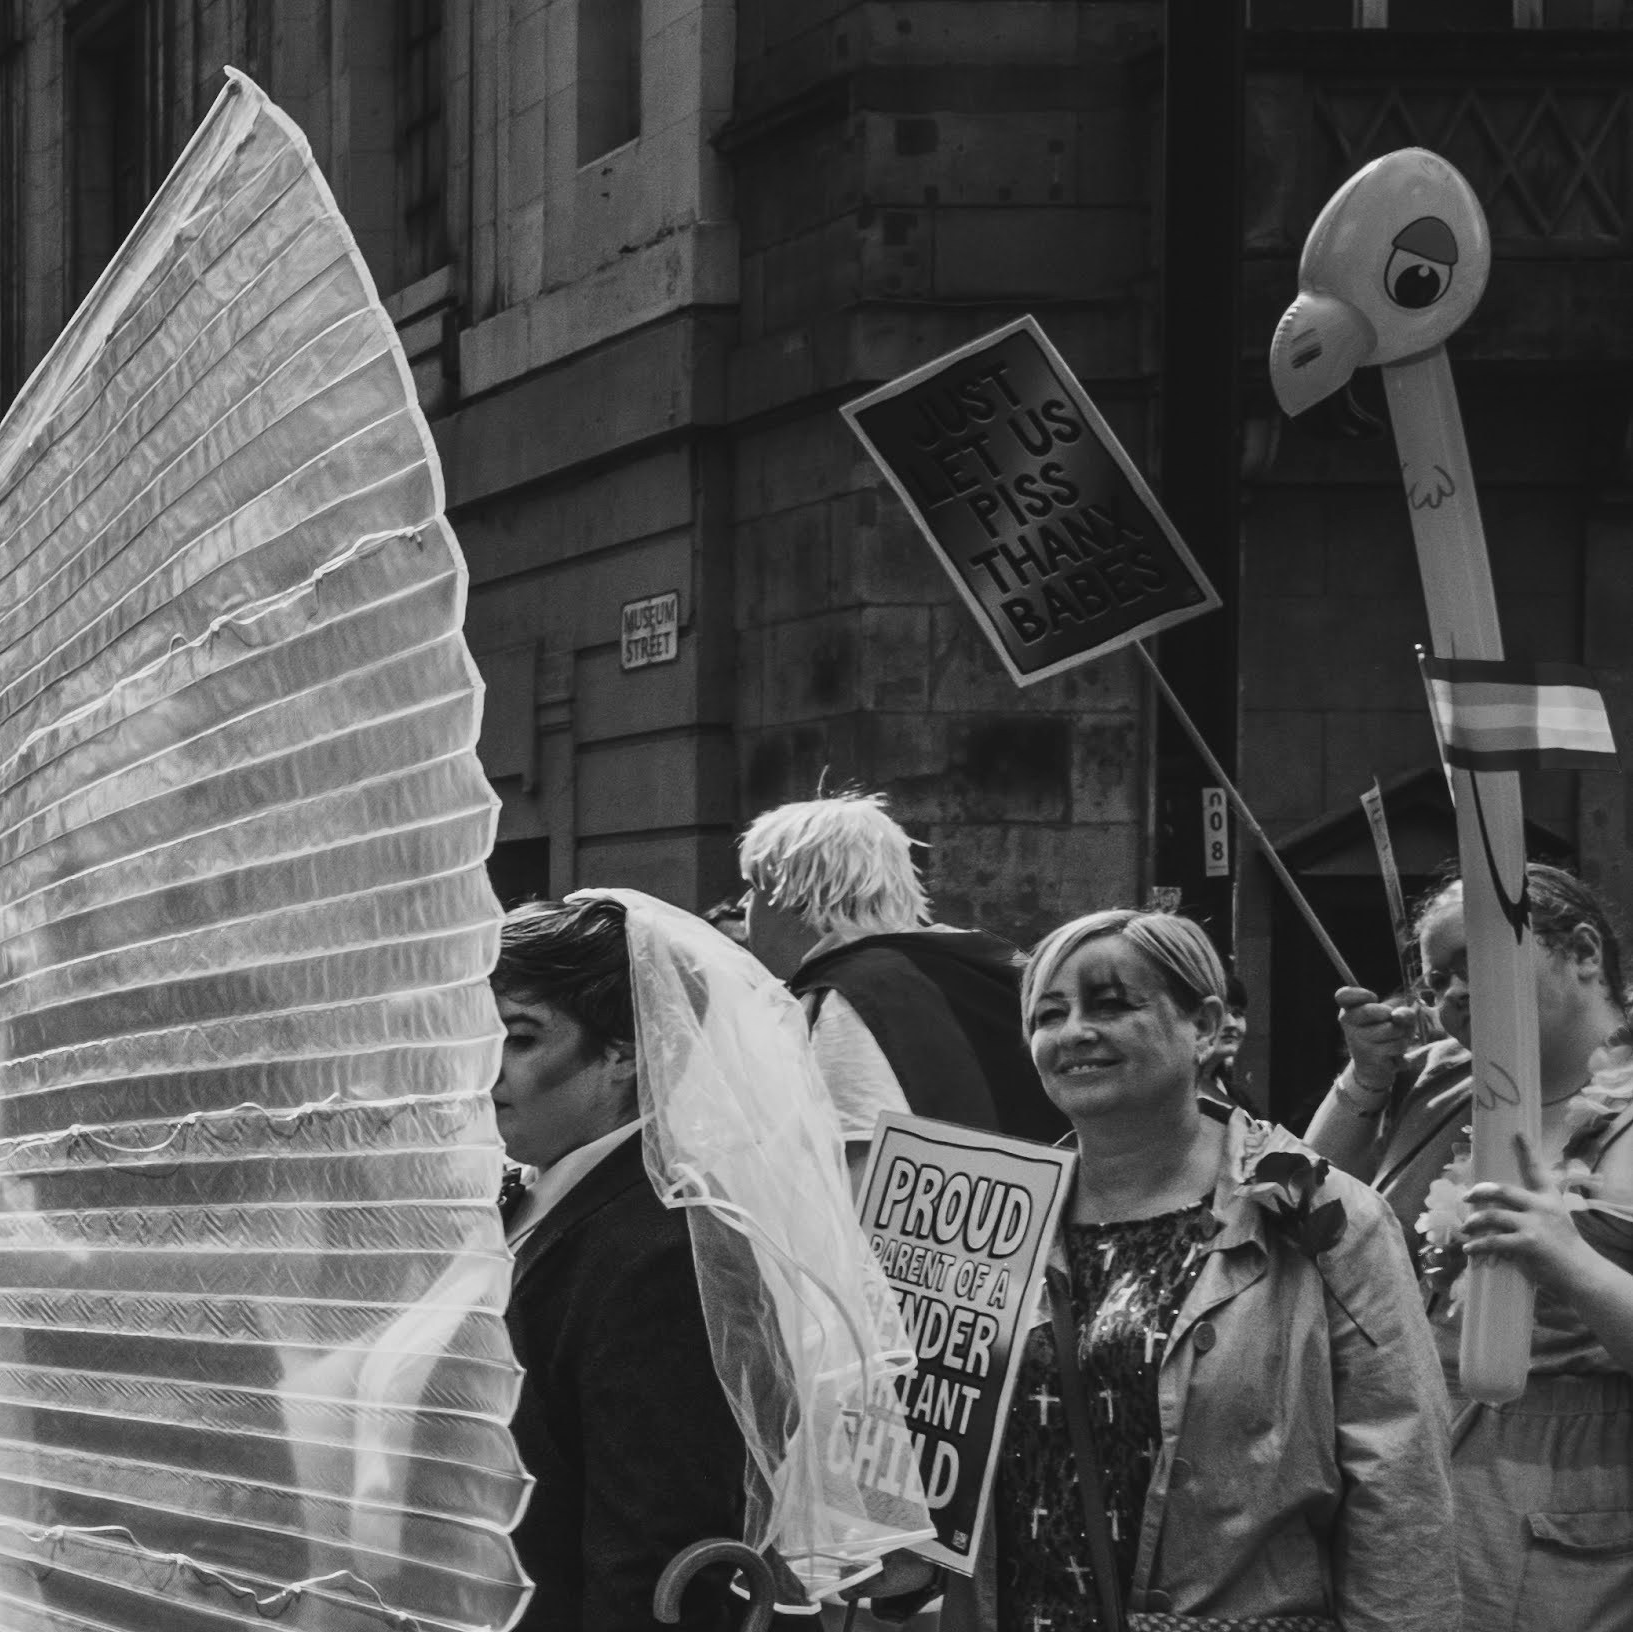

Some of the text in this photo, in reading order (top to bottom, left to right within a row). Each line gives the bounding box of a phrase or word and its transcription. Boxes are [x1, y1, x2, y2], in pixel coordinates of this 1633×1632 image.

[911, 361, 1022, 449] JUST
[907, 400, 1081, 510] LET US
[968, 461, 1079, 539] PISS
[623, 599, 676, 634] MUSEUM
[1000, 547, 1166, 645] BABES
[626, 631, 671, 662] STREET
[874, 1155, 1032, 1259] PROUD
[868, 1233, 1010, 1310] PARENT OF A
[876, 1287, 999, 1378] NDER
